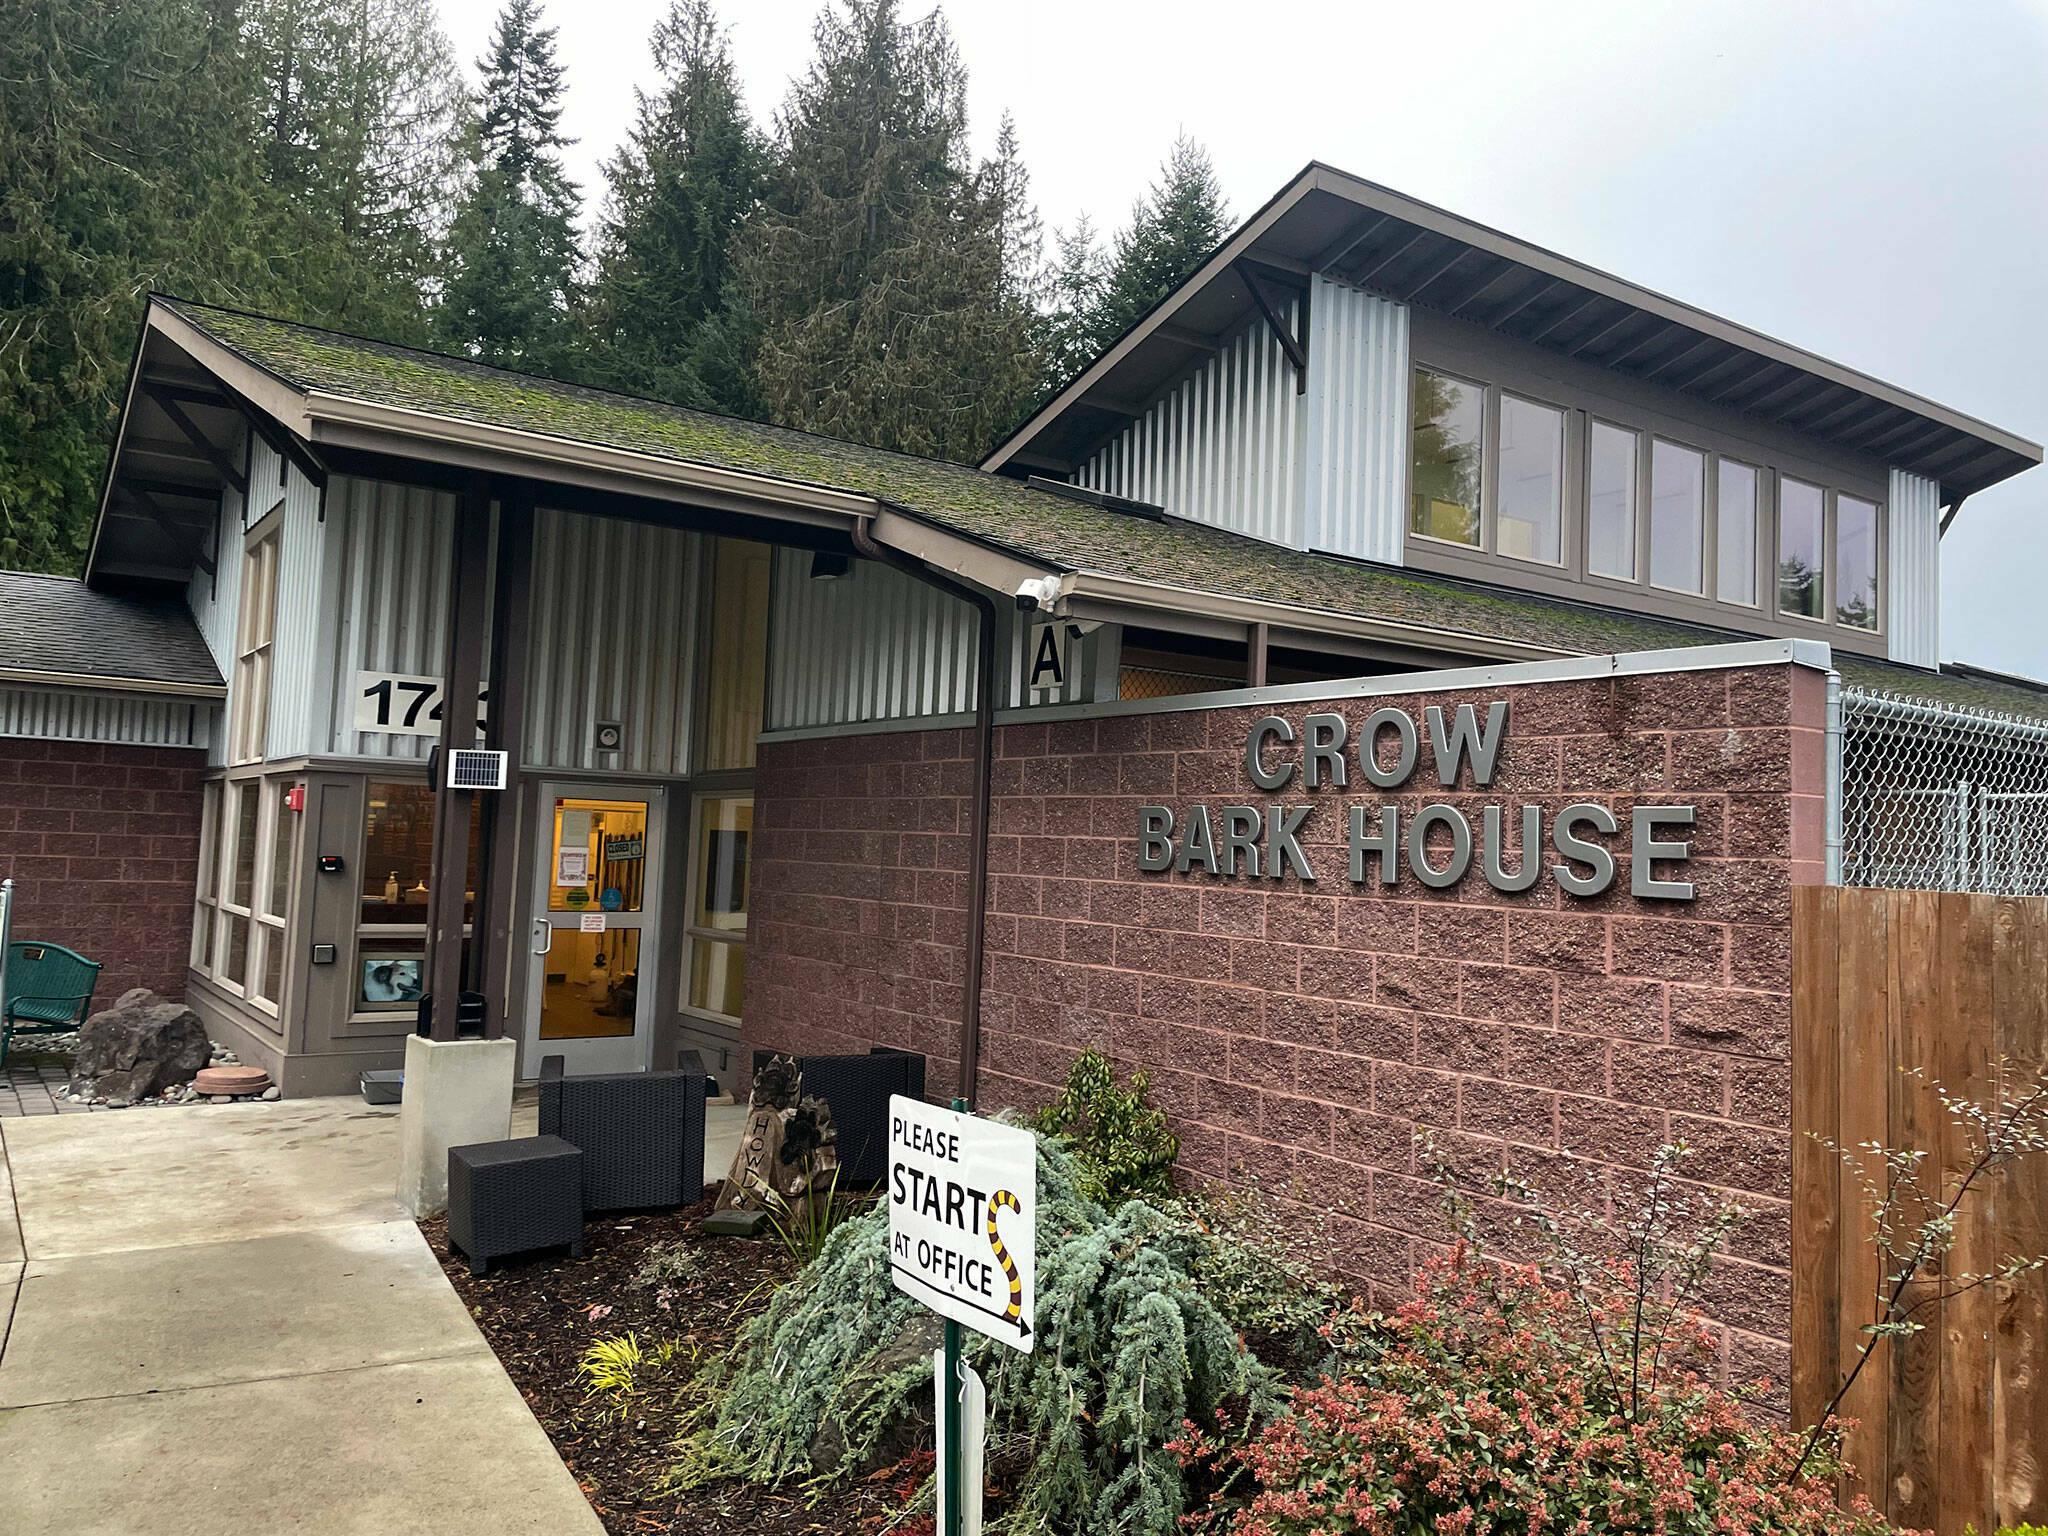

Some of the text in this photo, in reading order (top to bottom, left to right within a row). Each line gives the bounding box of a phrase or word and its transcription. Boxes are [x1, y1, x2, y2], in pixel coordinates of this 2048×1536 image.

[1030, 625, 1063, 685] A
[1246, 701, 1509, 790] CROW
[608, 843, 629, 853] CLOSED
[1138, 803, 1697, 900] BARK HOUSE
[736, 1117, 770, 1210] HOWDY
[893, 1117, 959, 1163] PLEASE
[893, 1162, 986, 1235] START
[894, 1231, 993, 1298] AT OFFICE
